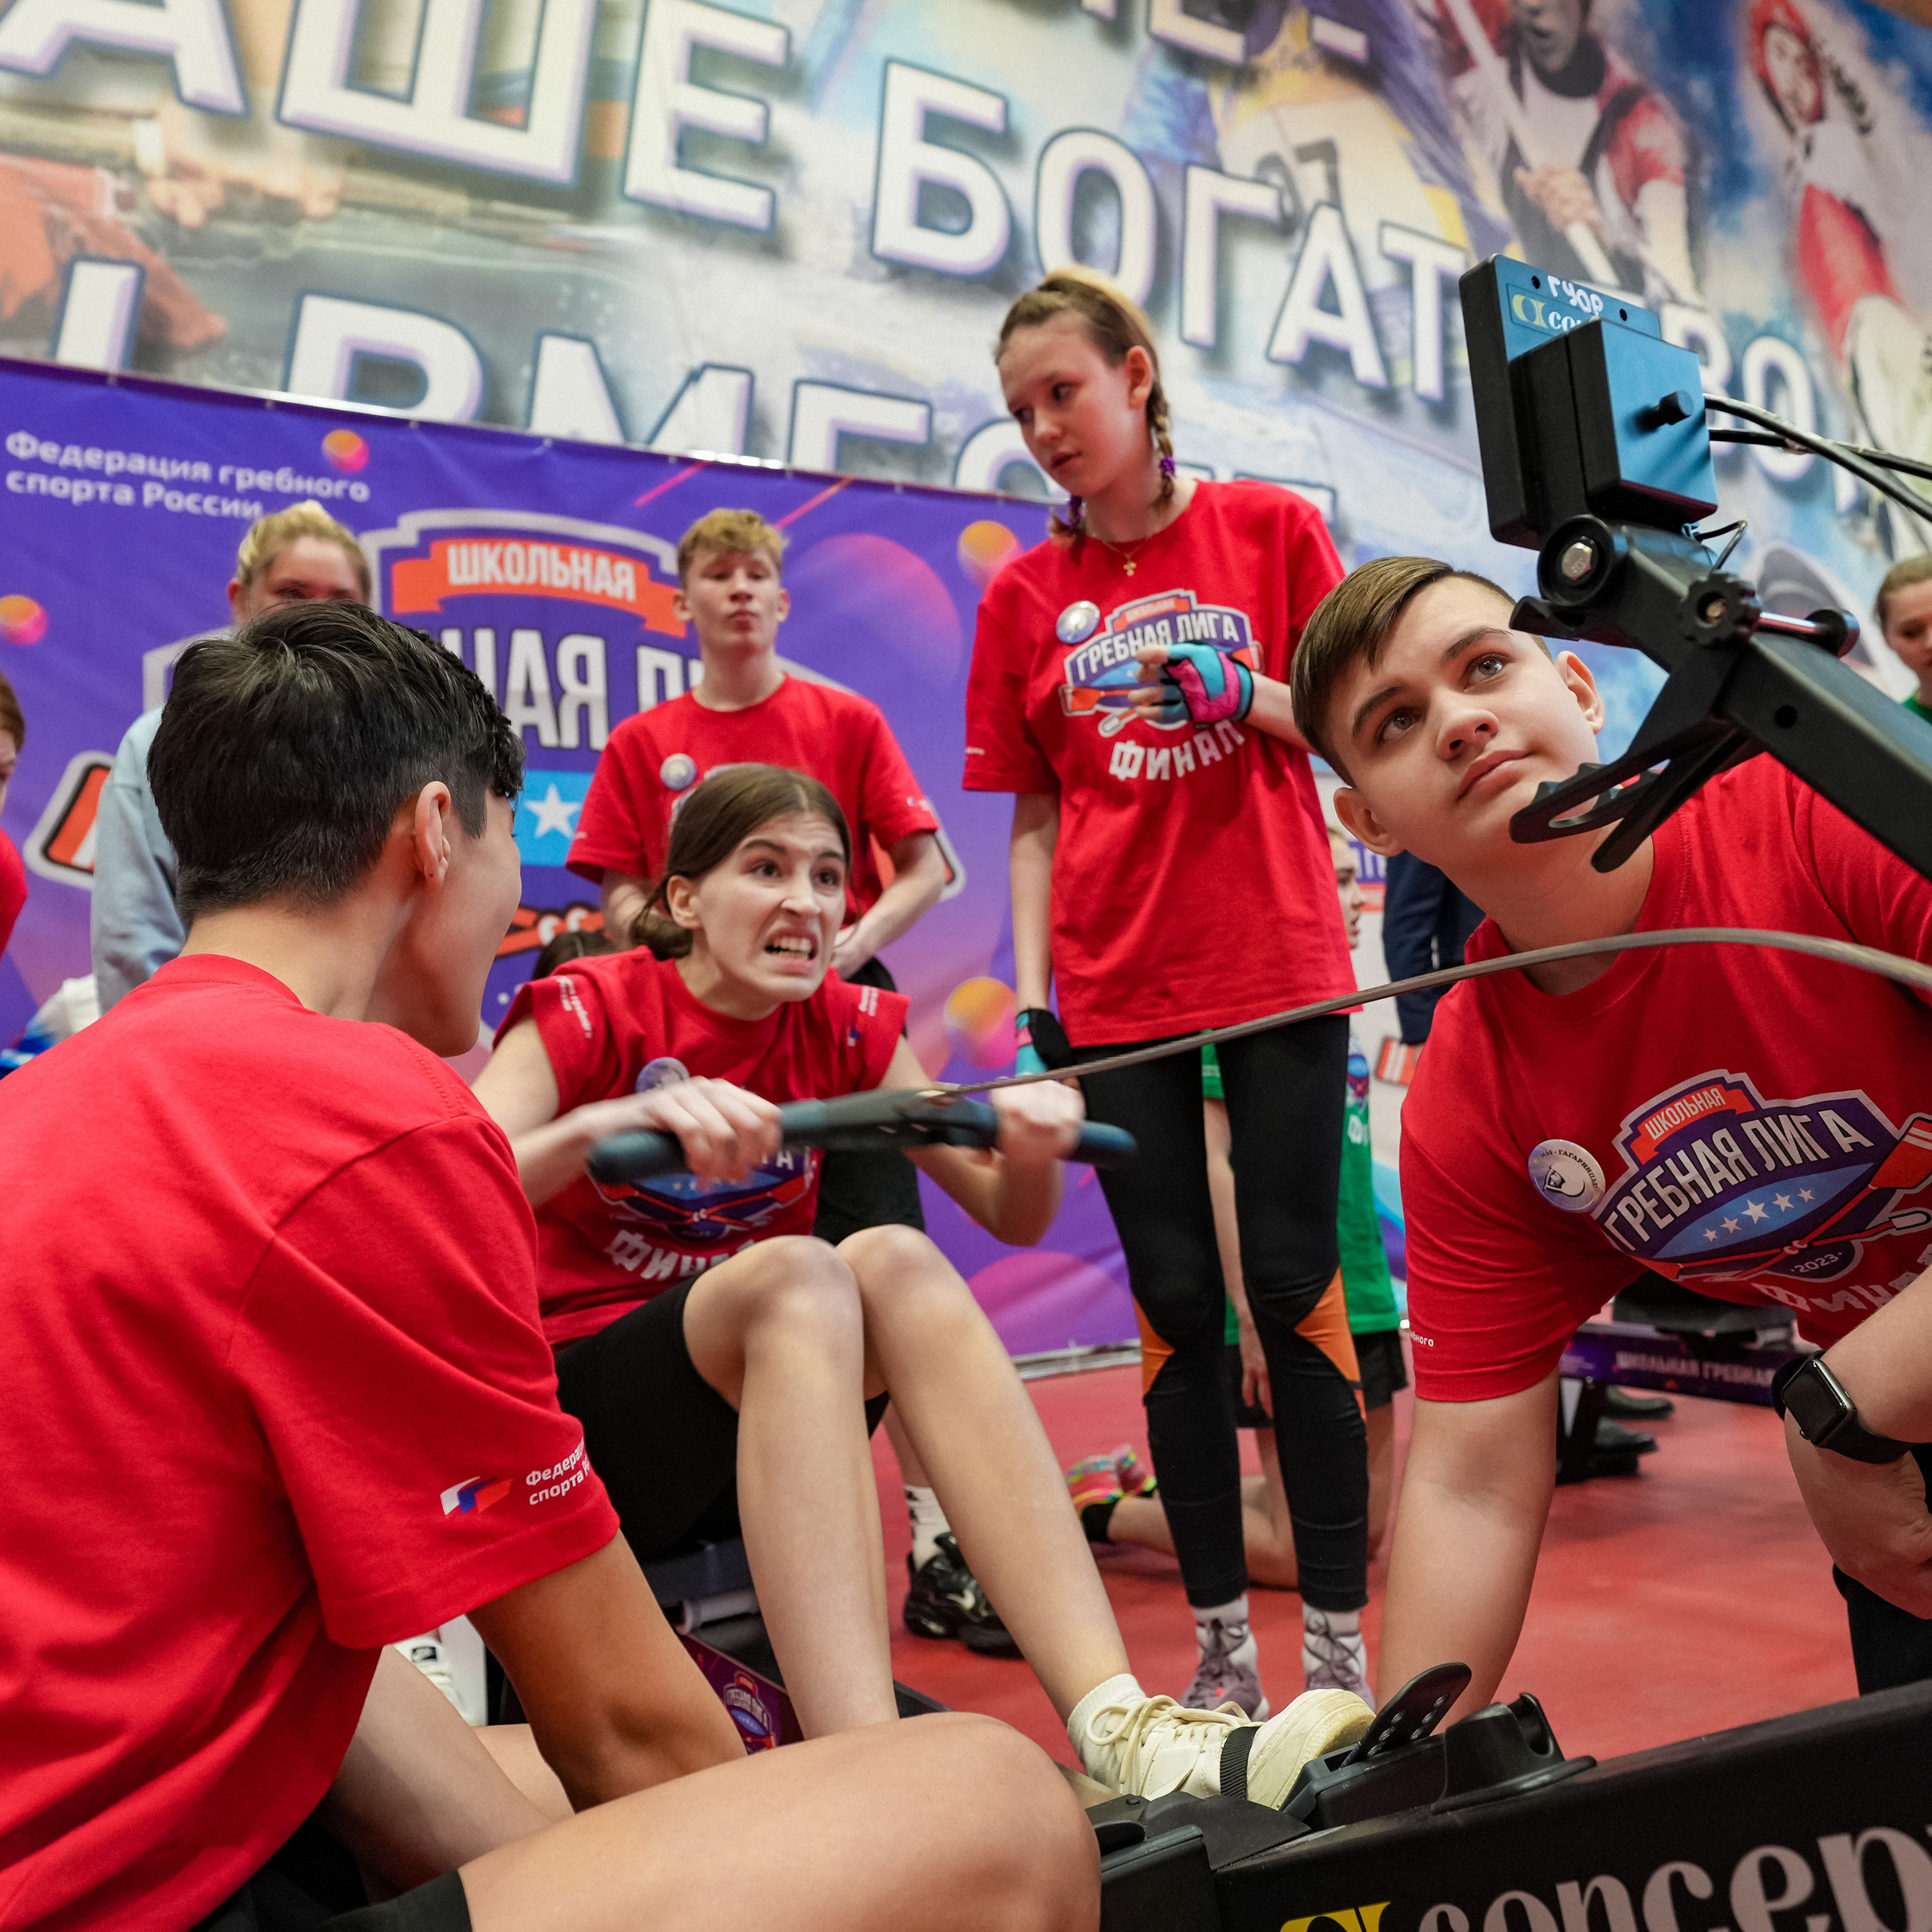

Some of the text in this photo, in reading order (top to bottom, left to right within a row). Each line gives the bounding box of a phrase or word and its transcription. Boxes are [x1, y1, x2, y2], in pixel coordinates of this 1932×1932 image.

[5, 431, 371, 503] Федерация гребного
[5, 469, 263, 519] спорта России
[448, 543, 635, 603] ШКОЛЬНАЯ
[1075, 611, 1240, 681] ГРЕБНАЯ ЛИГА
[1109, 718, 1245, 780] ФИНАЛ
[1644, 1087, 1726, 1141] ШКОЛЬНАЯ
[1540, 1149, 1553, 1159] МЫ
[1604, 1109, 1875, 1251] ГРЕБНАЯ ЛИГА
[529, 1469, 584, 1506] спорта
